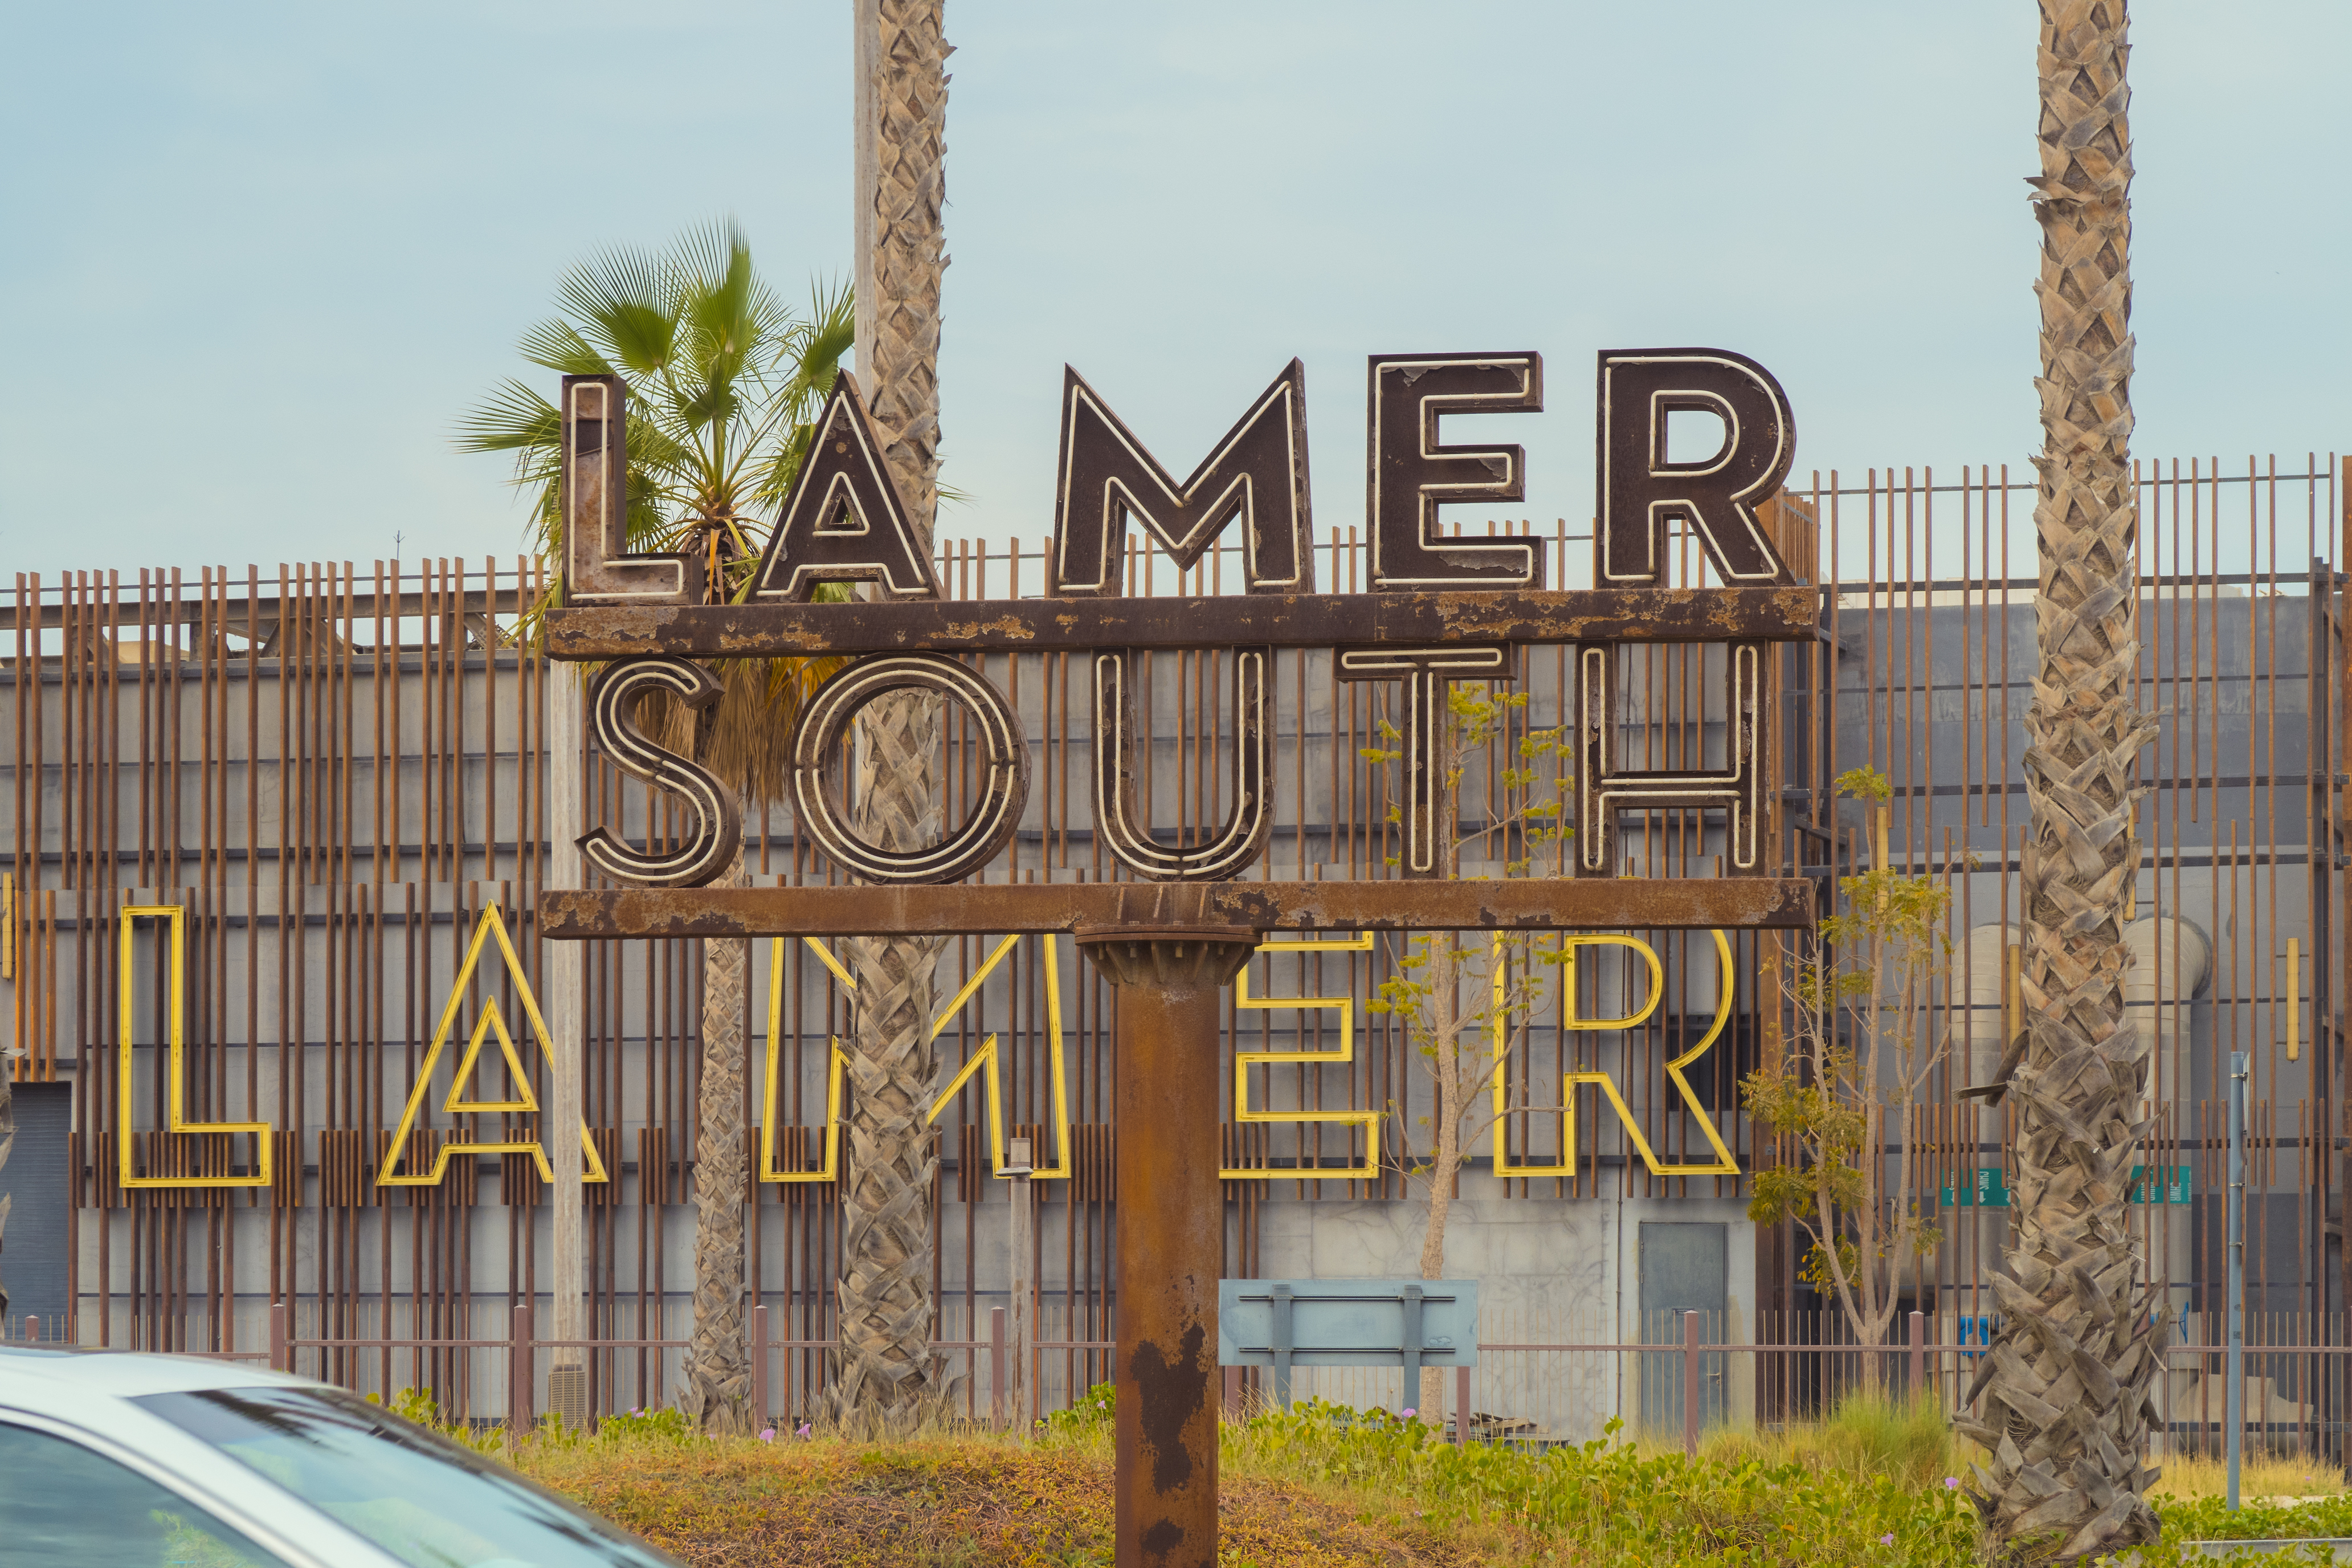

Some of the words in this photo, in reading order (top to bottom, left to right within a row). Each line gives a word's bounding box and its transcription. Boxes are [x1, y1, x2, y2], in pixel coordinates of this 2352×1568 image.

[562, 368, 947, 606] LA
[1051, 348, 1796, 599] MER
[574, 639, 1770, 888] SOUTH
[120, 899, 609, 1187] LA
